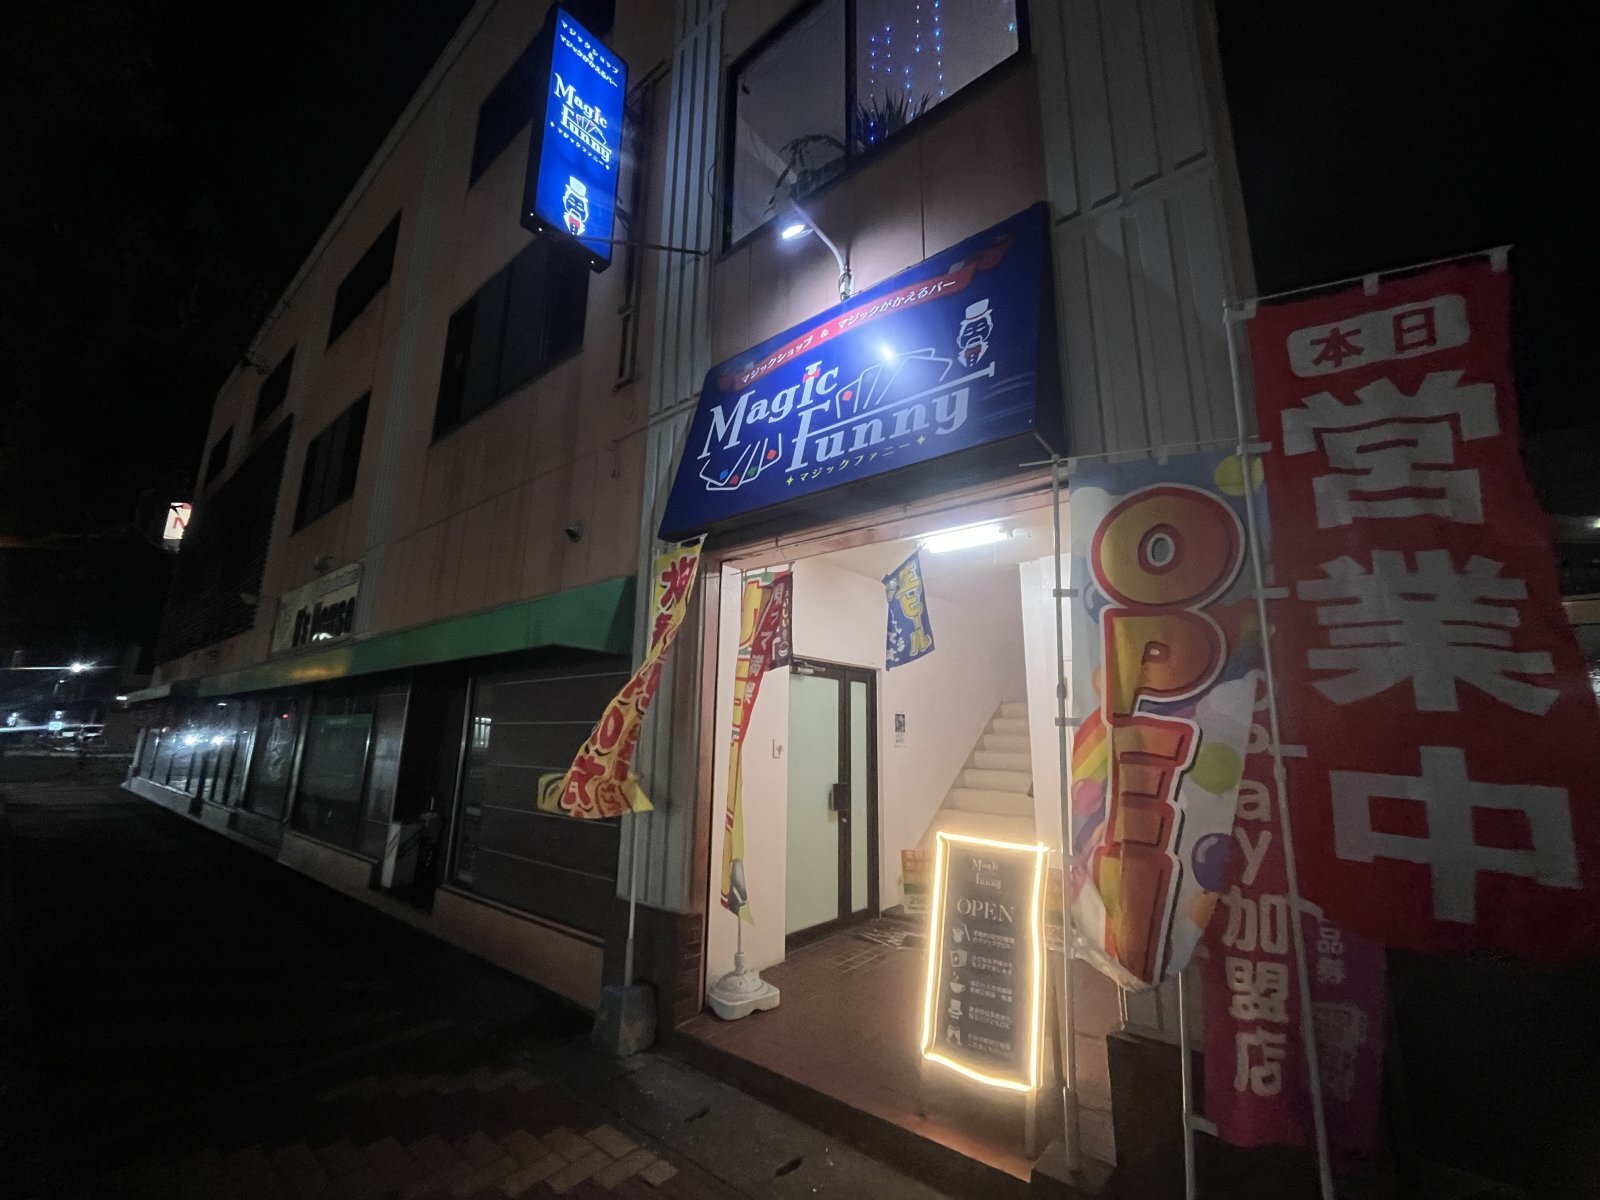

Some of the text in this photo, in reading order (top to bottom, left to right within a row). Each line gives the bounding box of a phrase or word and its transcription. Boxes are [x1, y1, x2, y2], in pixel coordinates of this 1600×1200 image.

[553, 72, 609, 128] Magic
[560, 103, 613, 163] Funny
[741, 280, 957, 384] マジックショップ & マジックがかえるバー
[1311, 306, 1437, 369] 本日
[697, 360, 841, 460] Magic
[785, 361, 996, 474] Funny
[798, 441, 912, 482] マジックファニー
[1280, 369, 1583, 925] 営業中
[956, 897, 1015, 924] OPEN
